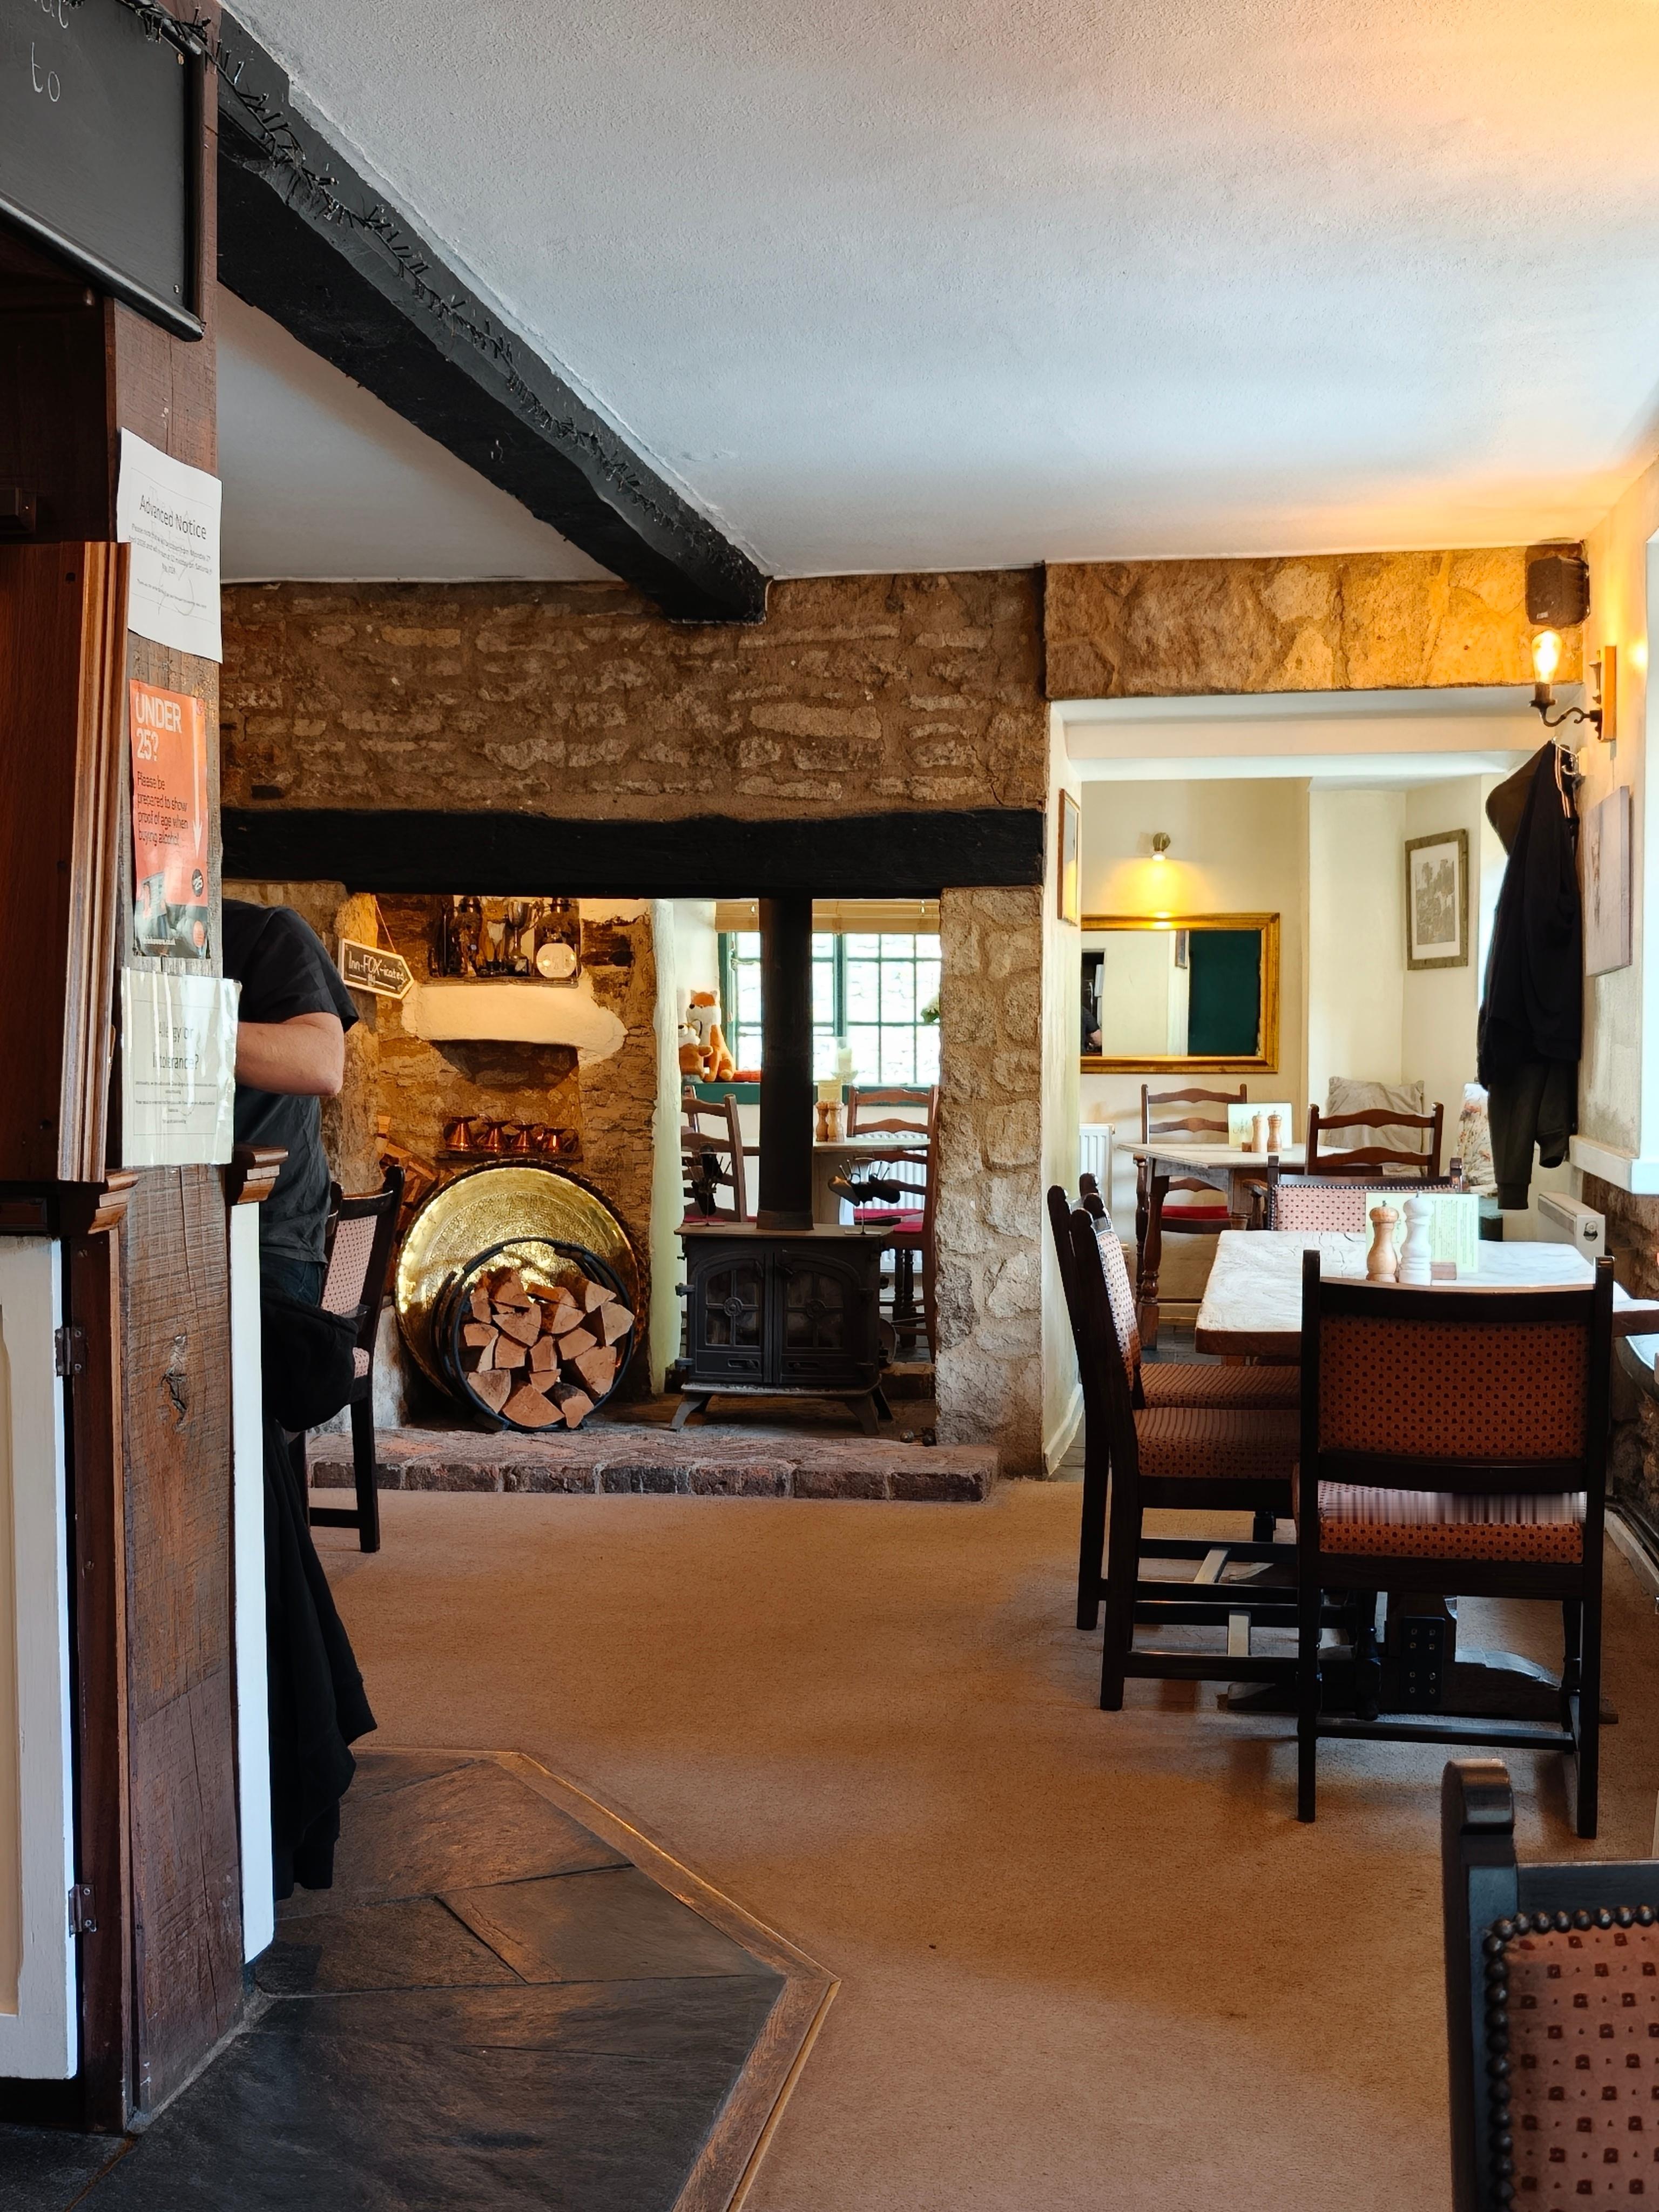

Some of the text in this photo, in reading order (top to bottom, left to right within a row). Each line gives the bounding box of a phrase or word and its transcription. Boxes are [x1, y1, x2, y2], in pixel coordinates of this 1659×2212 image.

[31, 42, 60, 103] to
[139, 494, 207, 540] Advanced Notice
[136, 693, 182, 733] UNDER
[136, 727, 159, 761] 25?
[137, 771, 166, 791] Please be
[137, 793, 188, 812] prepared to show
[137, 810, 188, 831] proof of age when
[138, 824, 180, 847] buying alcohol
[183, 1027, 194, 1040] or
